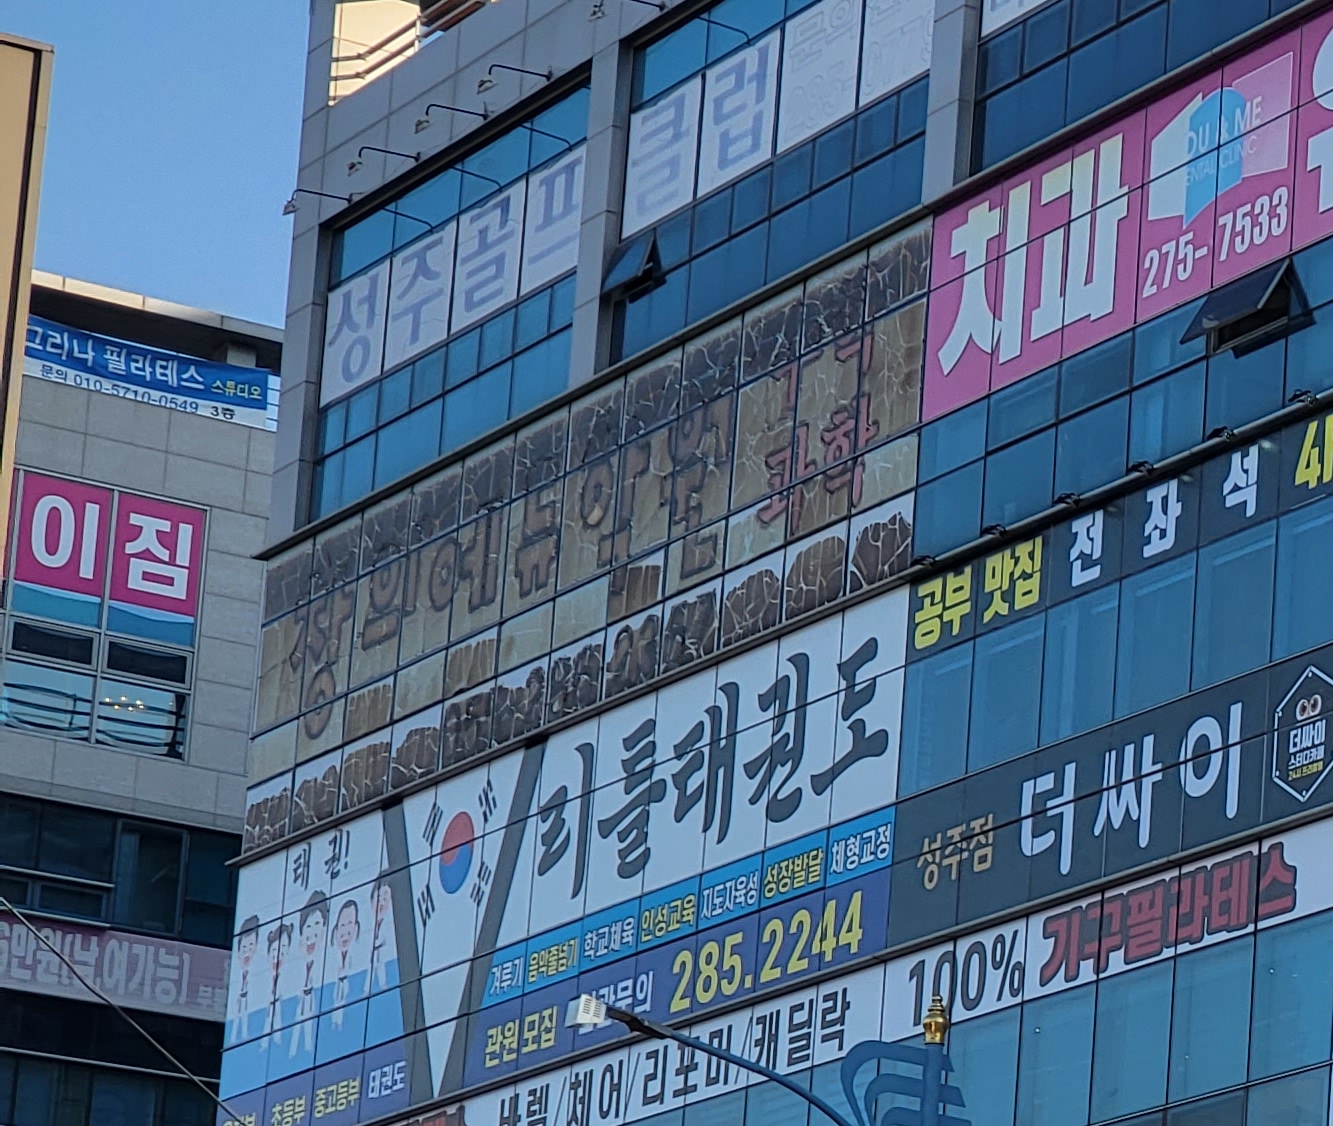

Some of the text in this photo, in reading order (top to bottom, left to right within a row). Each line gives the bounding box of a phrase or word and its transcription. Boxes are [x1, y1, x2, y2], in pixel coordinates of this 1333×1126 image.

[937, 132, 1129, 376] 치과
[1217, 186, 1289, 262] 7533
[39, 364, 236, 421] 문의 010-5710-0549 3층
[102, 343, 263, 400] 필라테스 스튜디오
[31, 494, 194, 601] 이짐
[914, 535, 1043, 650] 공부 맛집
[536, 635, 890, 899] 리틀태권도
[1289, 718, 1327, 754] 더싸이
[917, 813, 994, 891] 성주점
[1020, 702, 1244, 875] 더싸이
[489, 822, 893, 997] 겨루기 음악줄넘기 학교체육 인성교육 지도자육성 성장발달 체형교정
[669, 889, 864, 1014] 285.2244
[907, 842, 1298, 1027] 100% 기구필라테스
[313, 1077, 361, 1118] 중고등부
[368, 1059, 408, 1098] 태권도
[485, 1005, 558, 1068] 관원 모집
